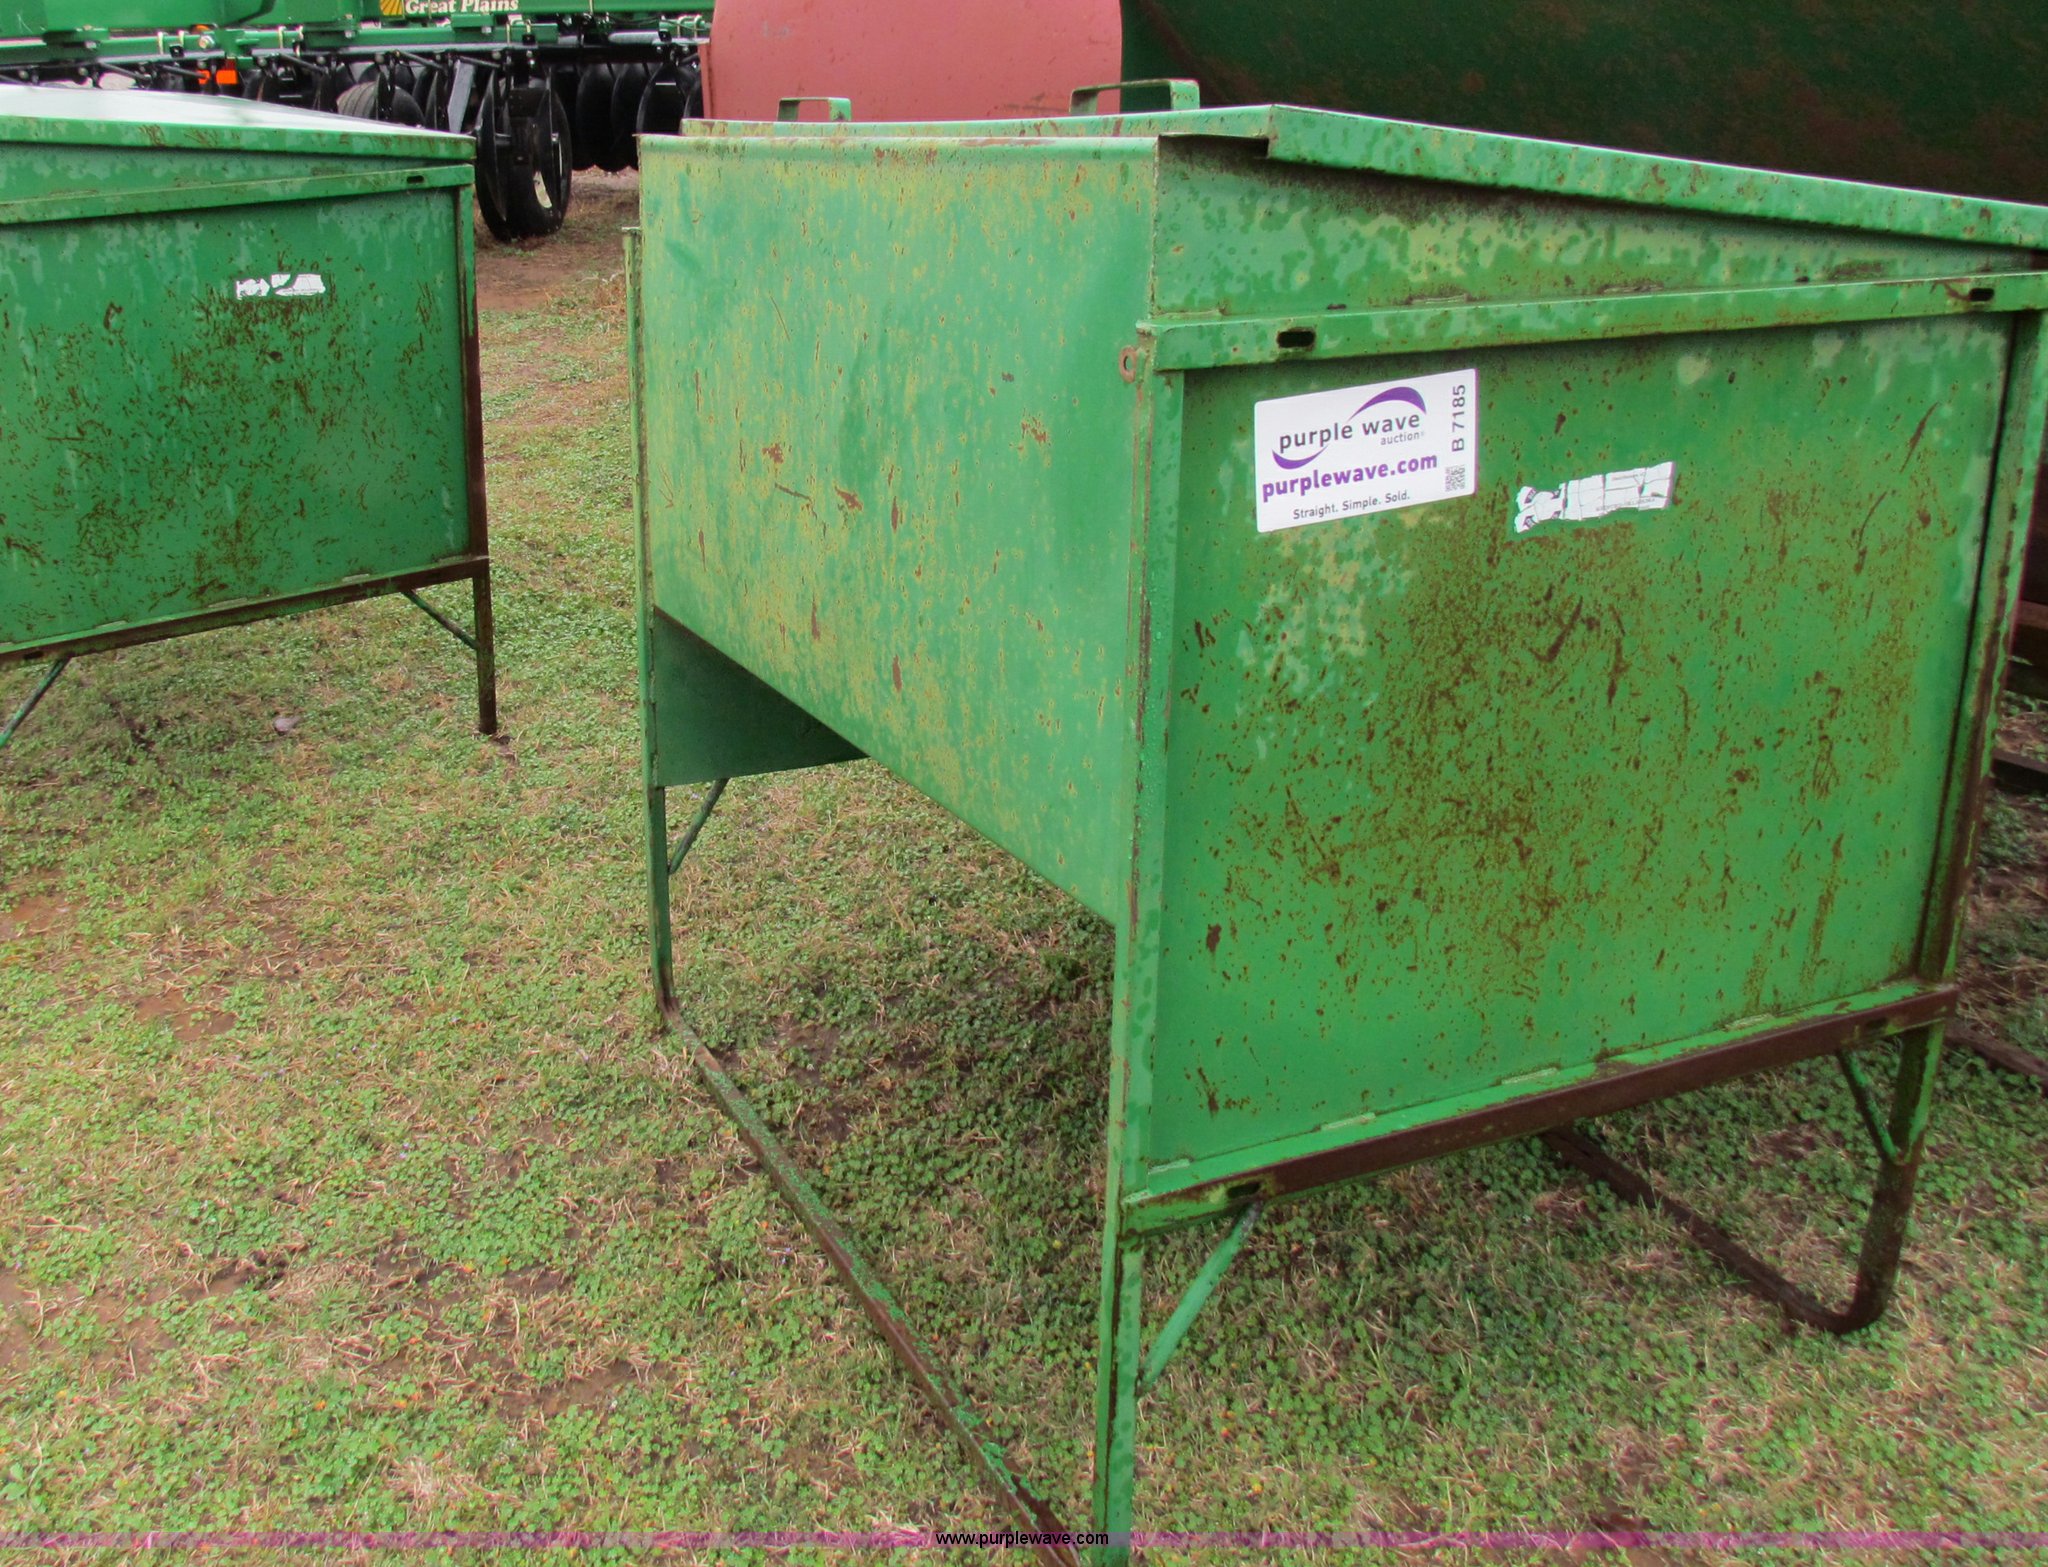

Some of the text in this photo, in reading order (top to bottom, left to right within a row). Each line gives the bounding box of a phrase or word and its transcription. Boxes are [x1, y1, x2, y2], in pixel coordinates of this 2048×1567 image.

[404, 0, 519, 14] Great Plains
[1279, 414, 1420, 454] purple wave
[1451, 384, 1466, 452] B 7185
[1380, 431, 1420, 446] auction
[1262, 454, 1438, 503] purplewave.com
[1293, 490, 1410, 520] Straight. Simple. Sold.
